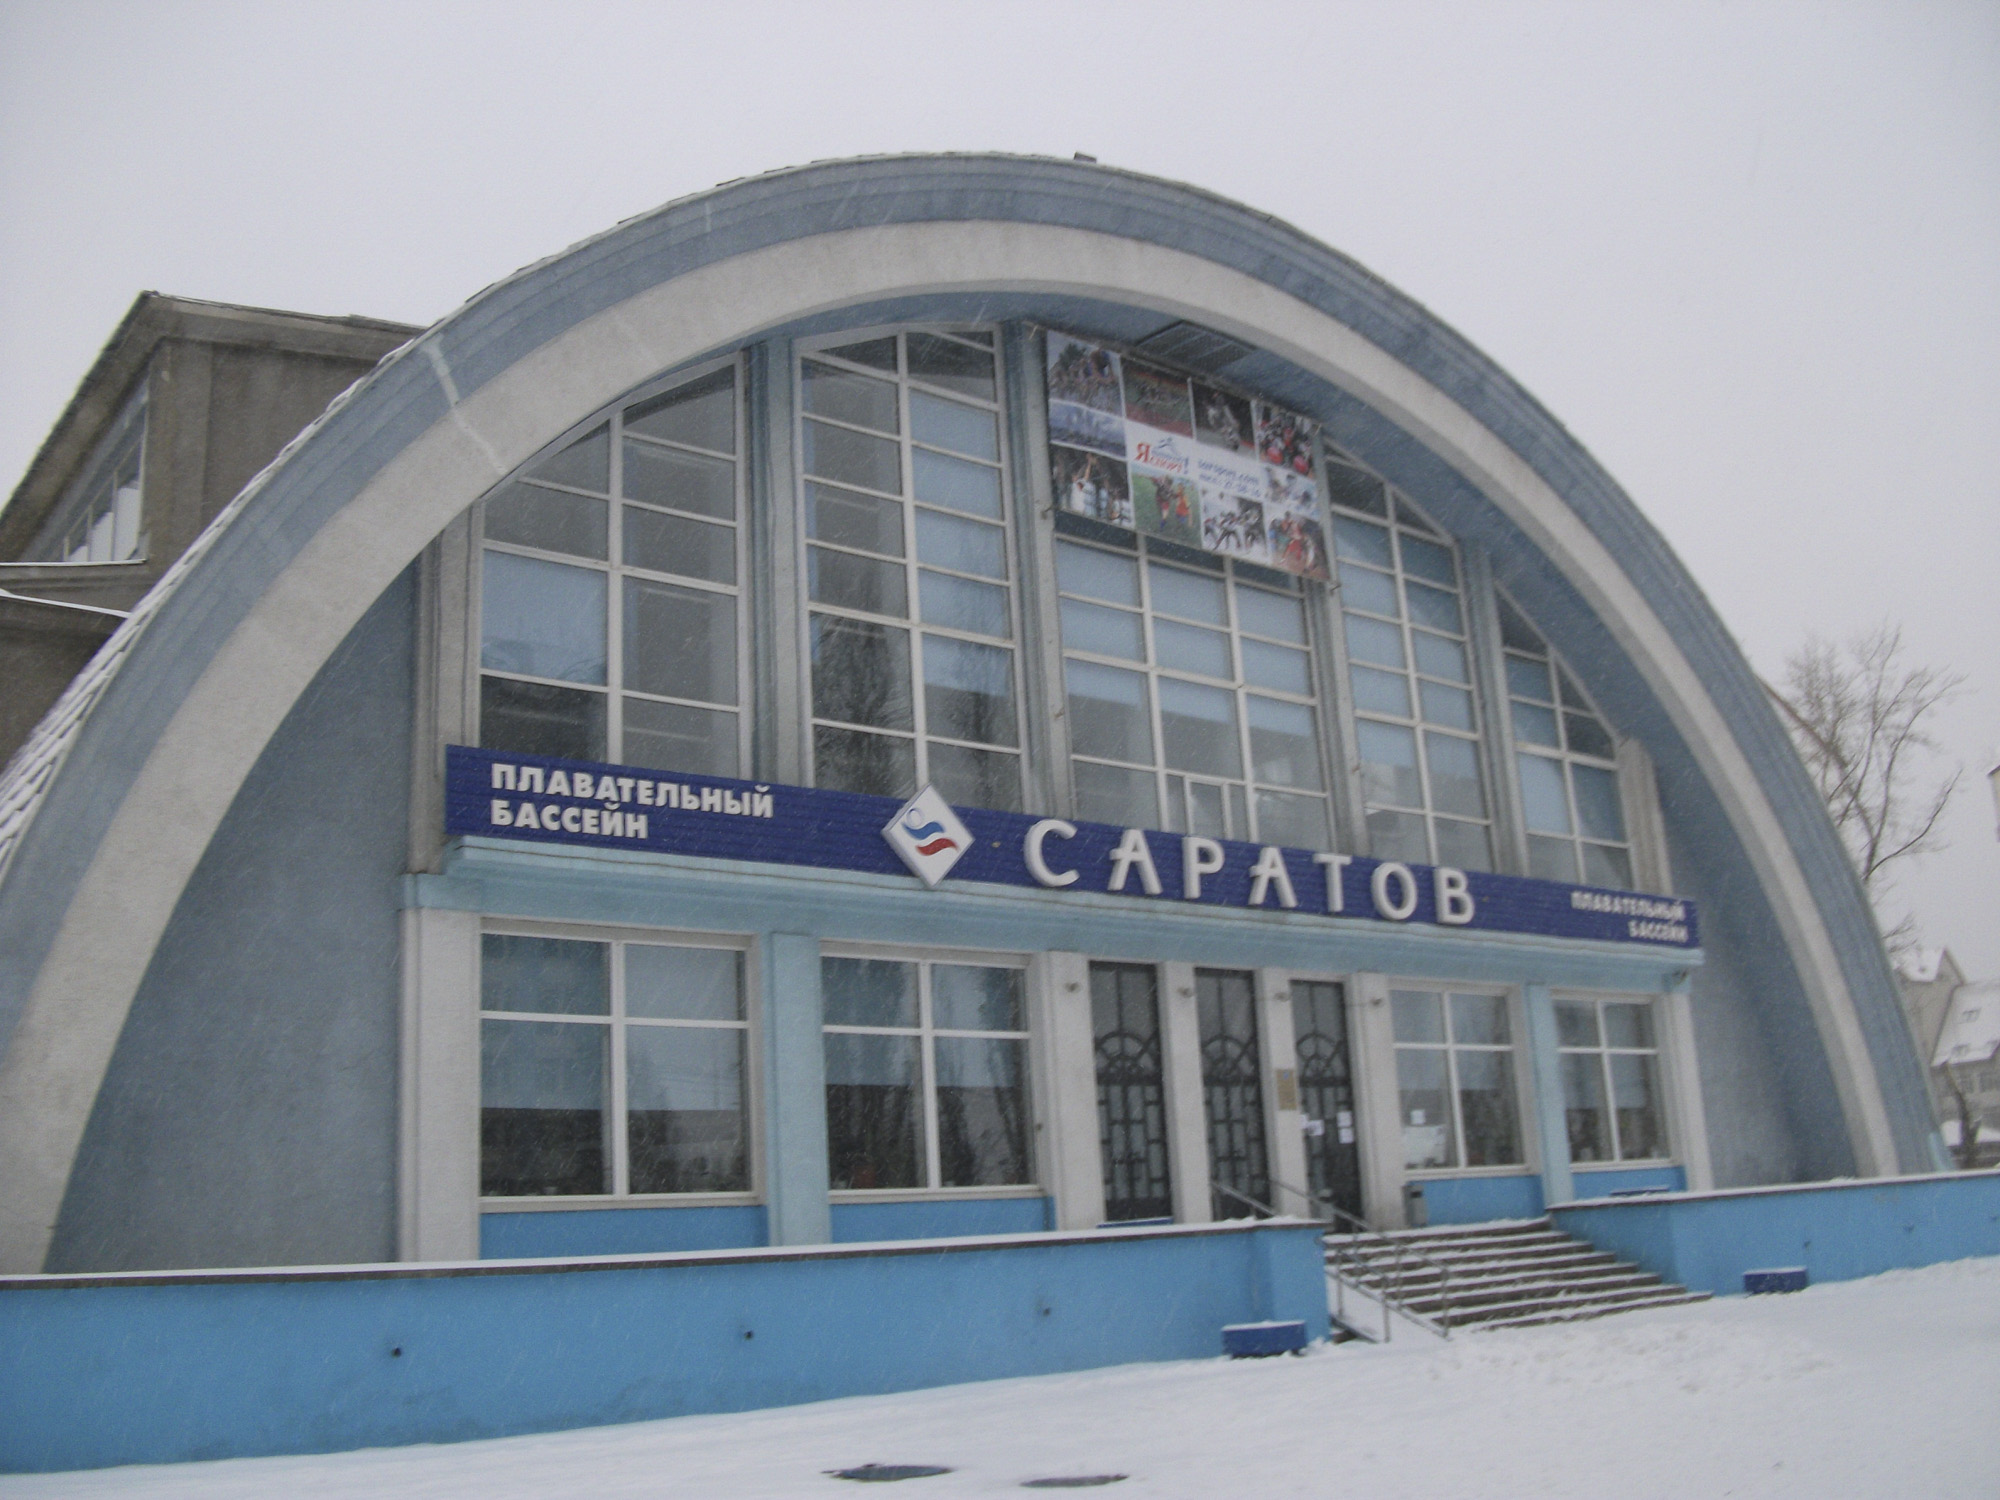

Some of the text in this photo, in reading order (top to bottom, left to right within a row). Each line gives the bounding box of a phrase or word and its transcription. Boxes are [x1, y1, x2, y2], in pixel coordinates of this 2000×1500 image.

[491, 763, 774, 819] ПЛАВАТЕЛЬНЫЙ
[490, 800, 648, 839] БАССЕЙН
[1023, 819, 1475, 925] САРАТОВ
[1570, 890, 1687, 921] ПЛАВАТЕЛЬНЫЙ
[1628, 921, 1689, 943] БАССЕЙН
